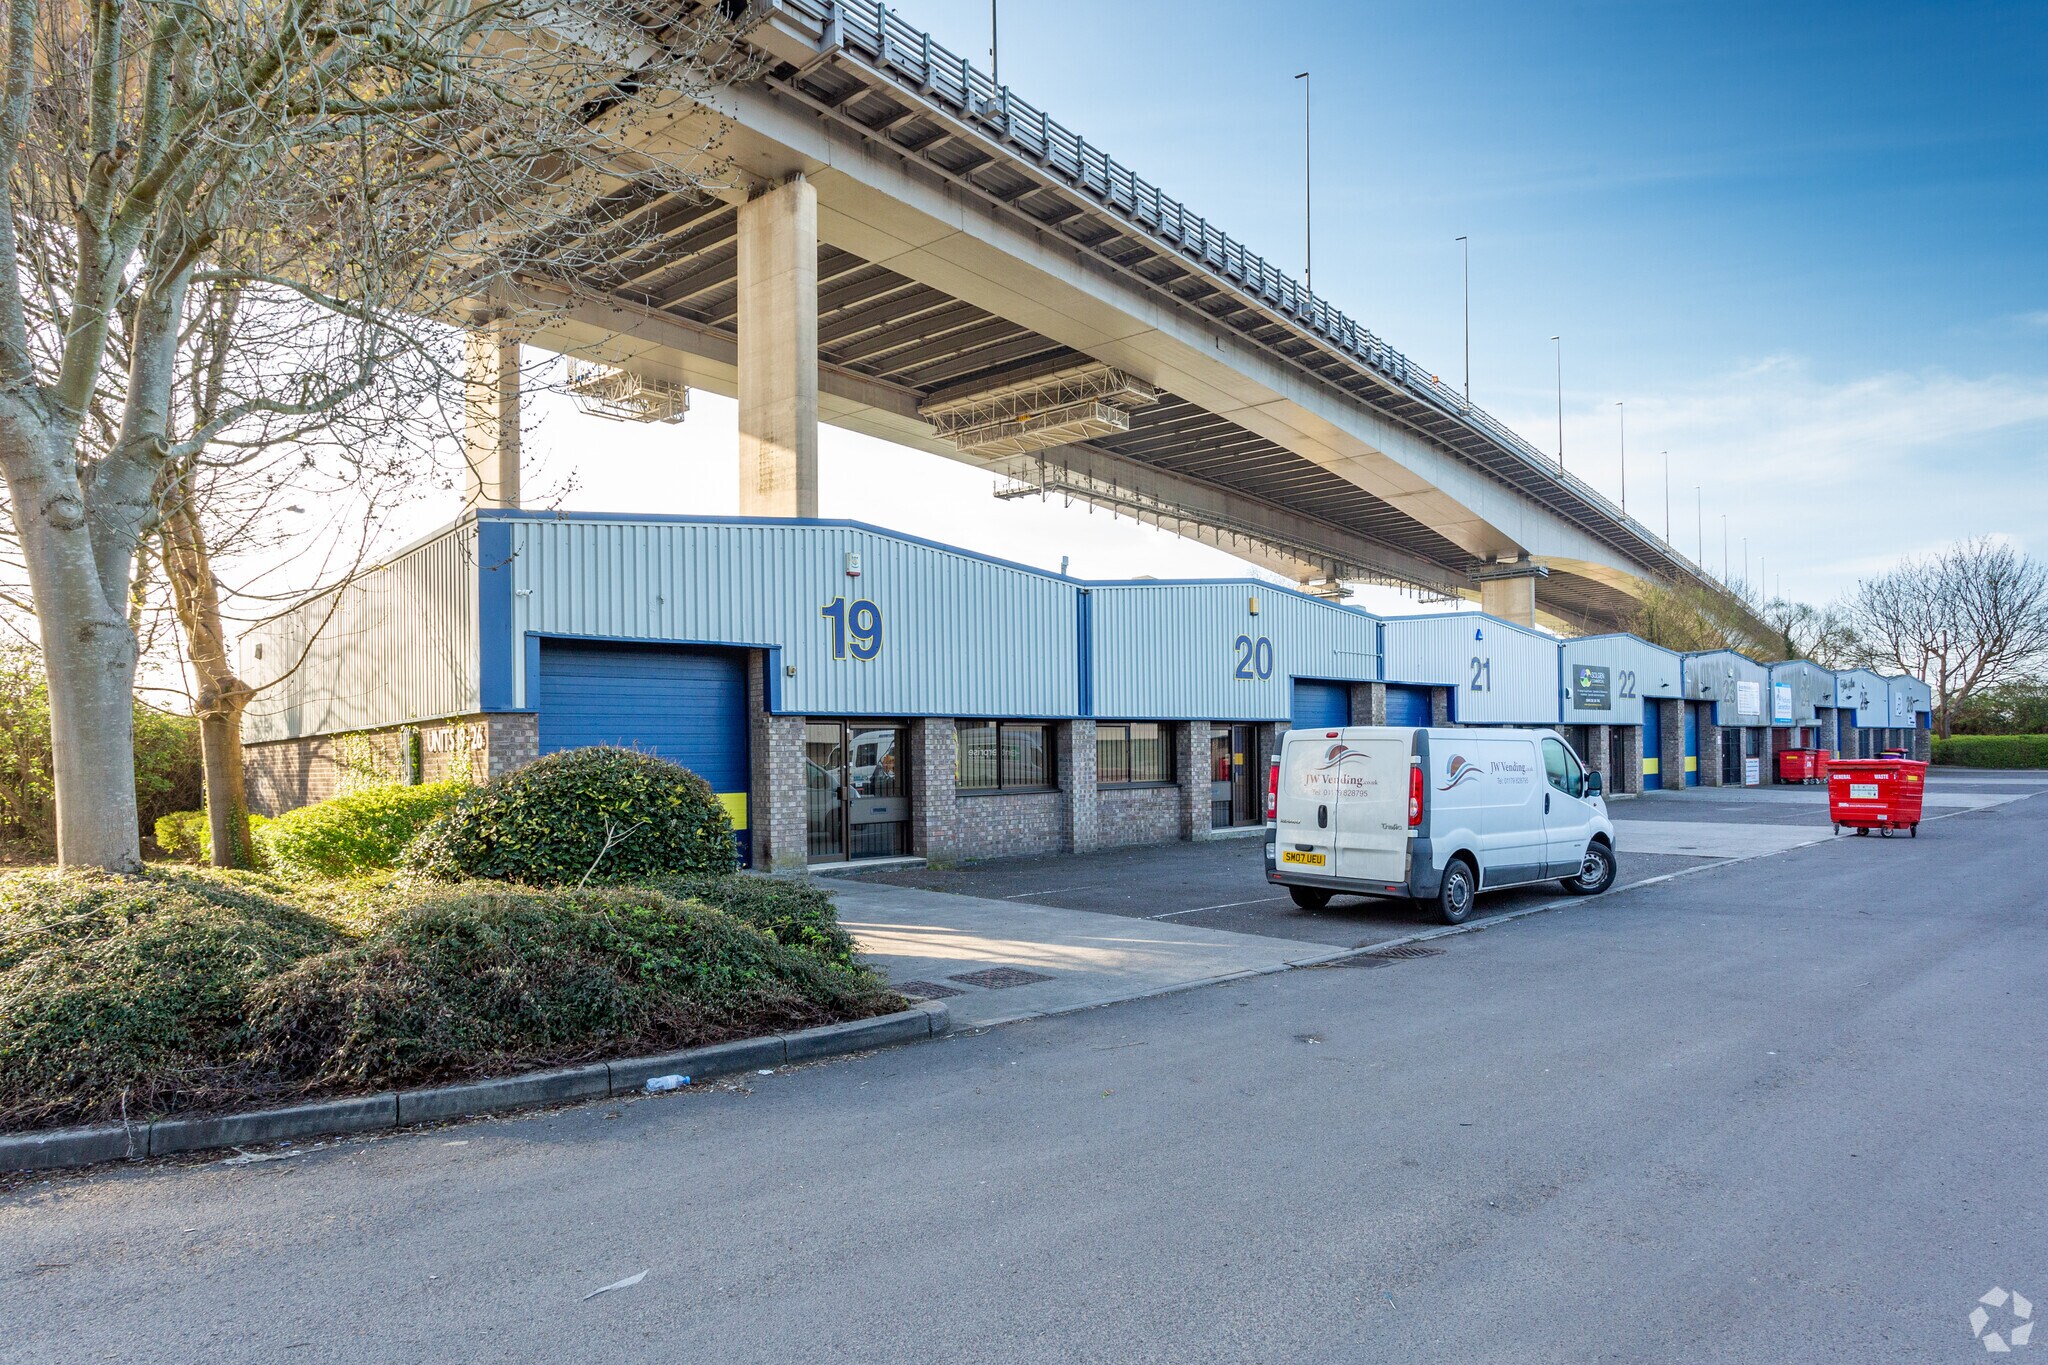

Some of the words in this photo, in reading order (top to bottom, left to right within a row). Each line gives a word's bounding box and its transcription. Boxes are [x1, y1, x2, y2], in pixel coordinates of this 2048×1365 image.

[820, 596, 884, 661] 19
[1233, 633, 1274, 681] 20
[1470, 656, 1490, 692] 21
[1619, 670, 1636, 698] 22
[1722, 680, 1736, 703] 23
[1860, 691, 1868, 711] 25
[428, 729, 455, 752] UNITS
[457, 726, 466, 751] 19
[471, 725, 483, 749] 26
[1490, 761, 1500, 774] JW
[1304, 774, 1320, 786] JW
[1343, 789, 1368, 797] 828795
[1285, 852, 1306, 863] SM07
[1306, 854, 1322, 865] UEU
